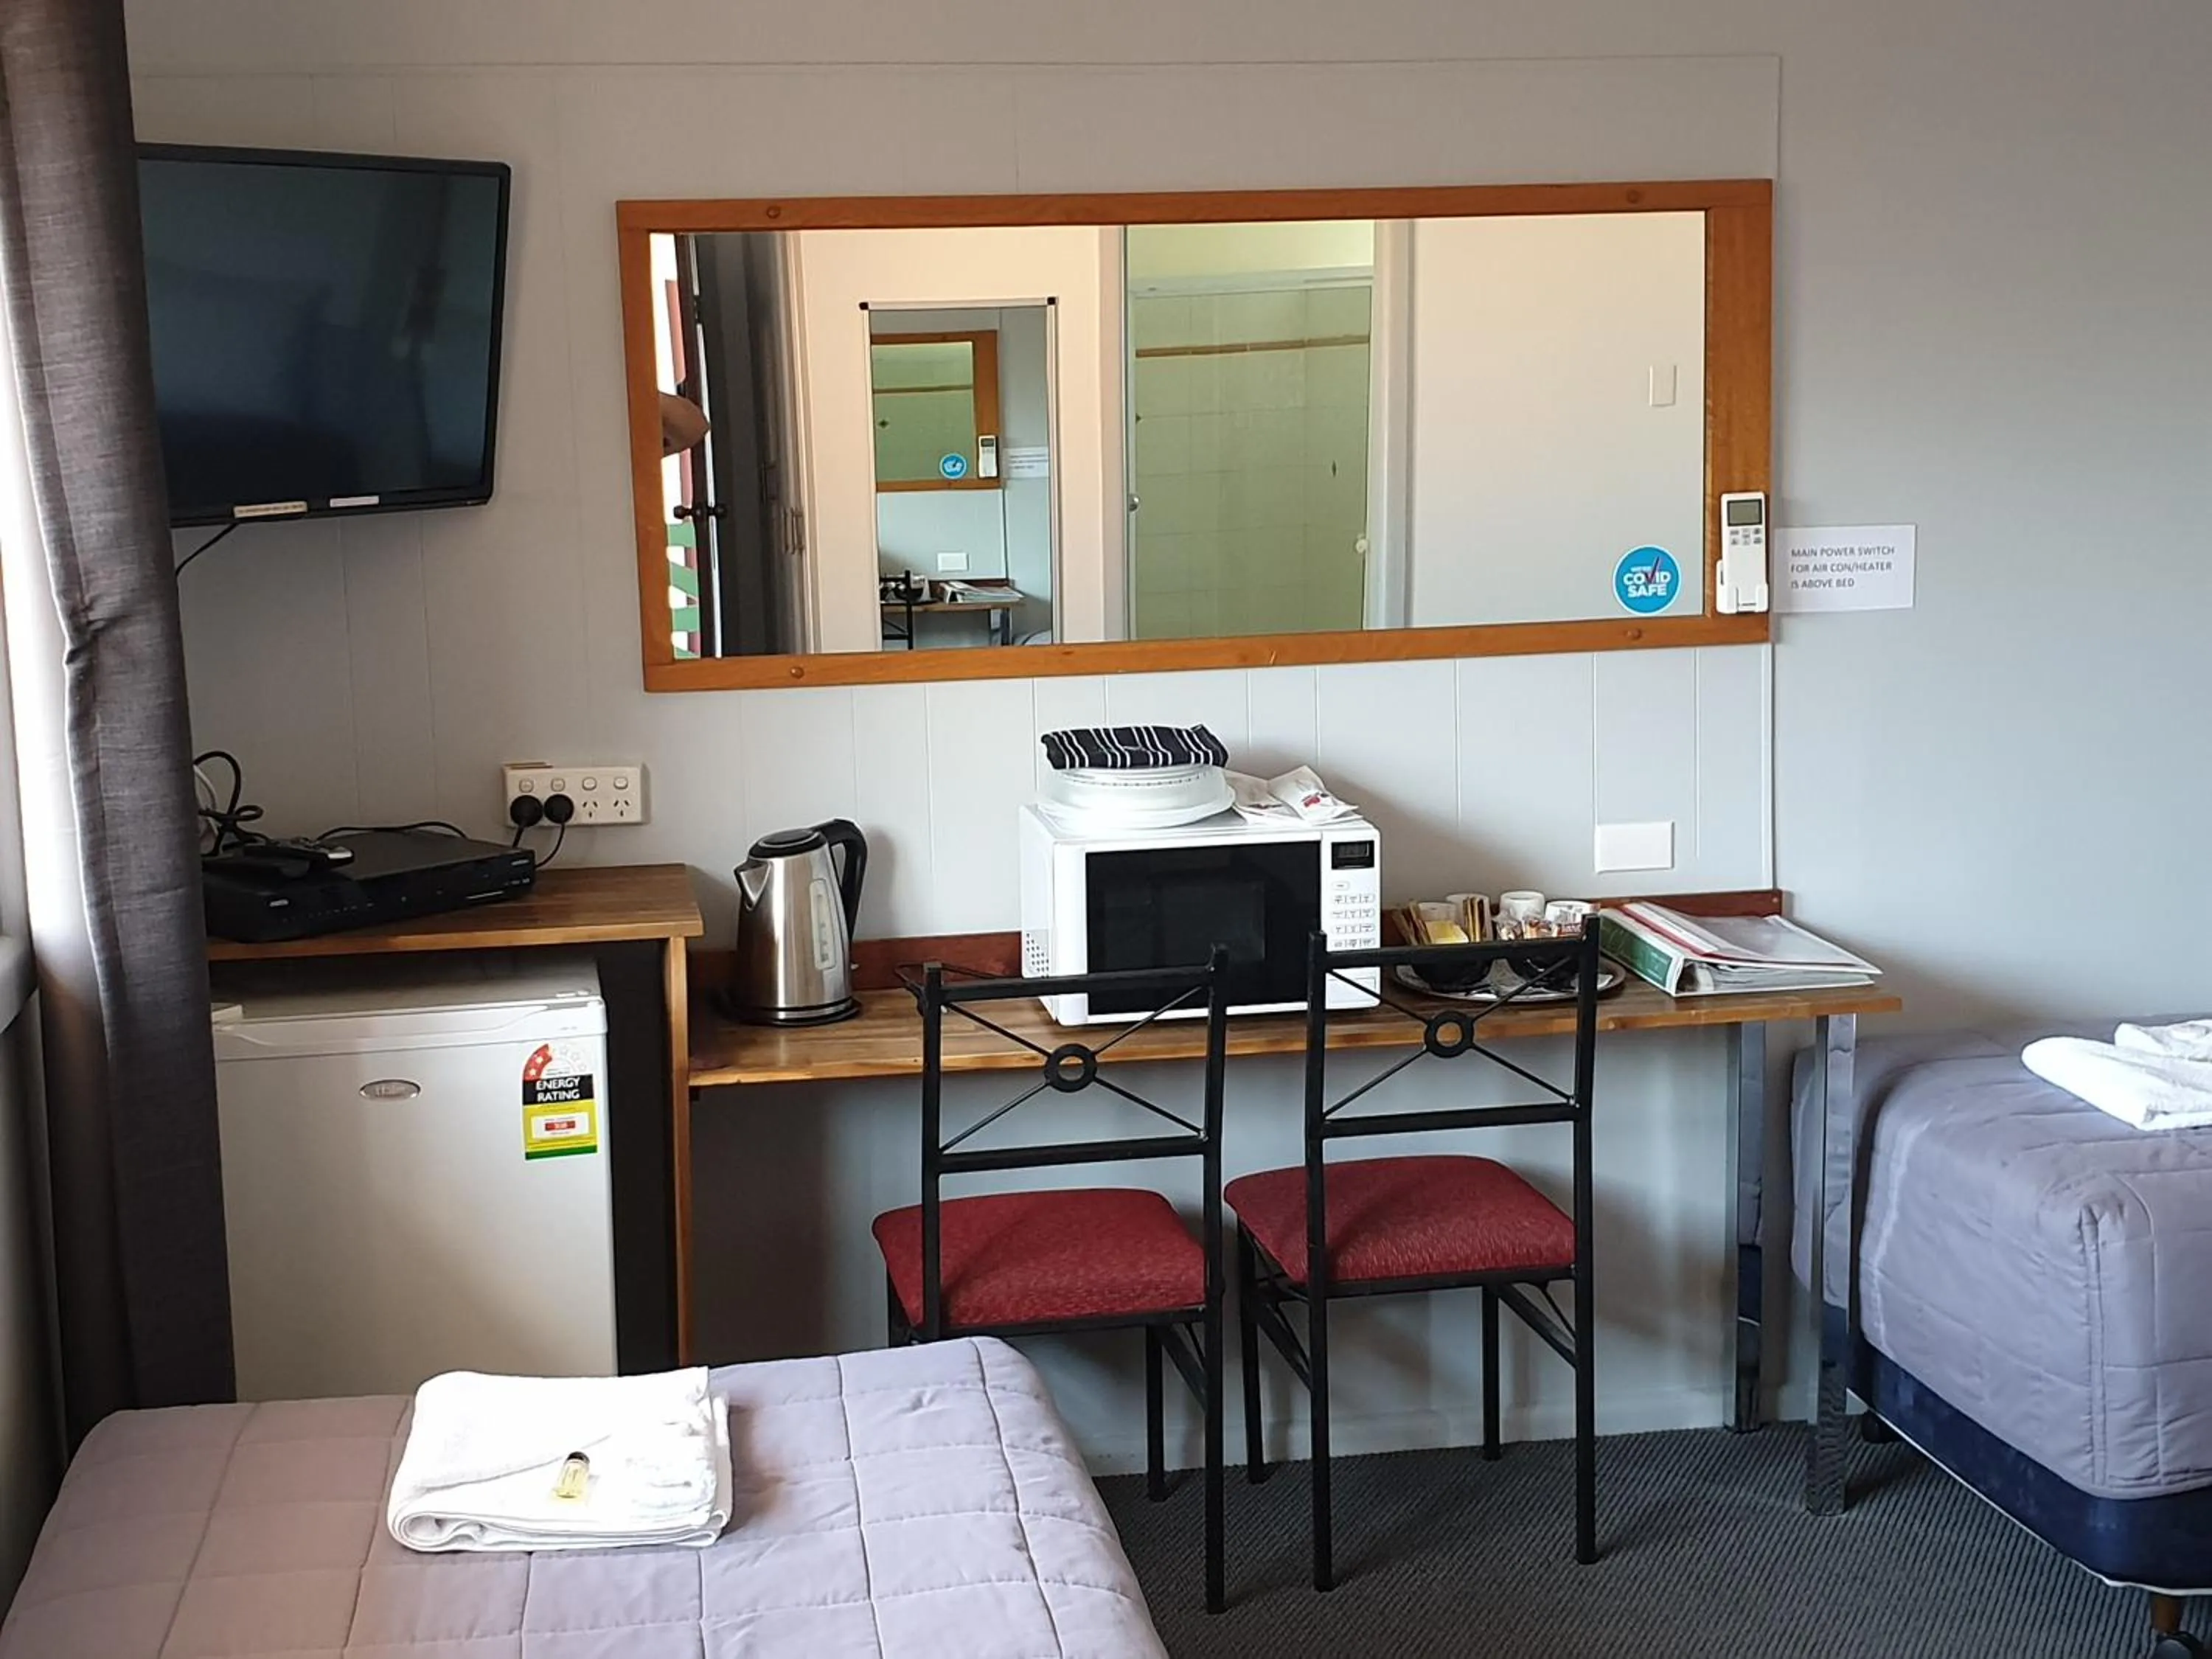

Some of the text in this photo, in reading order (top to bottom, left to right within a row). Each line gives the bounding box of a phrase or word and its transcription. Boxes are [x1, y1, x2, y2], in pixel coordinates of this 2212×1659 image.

[1791, 546, 1895, 557] MAIN POWER SWITCH
[1791, 561, 1892, 573] FOR AIR CON/HEATER
[1623, 565, 1672, 585] COVID
[1791, 577, 1855, 589] IS ABOVE BED
[1627, 583, 1667, 598] SAFE
[535, 1077, 580, 1091] ENERGY
[537, 1089, 580, 1102] RATING
